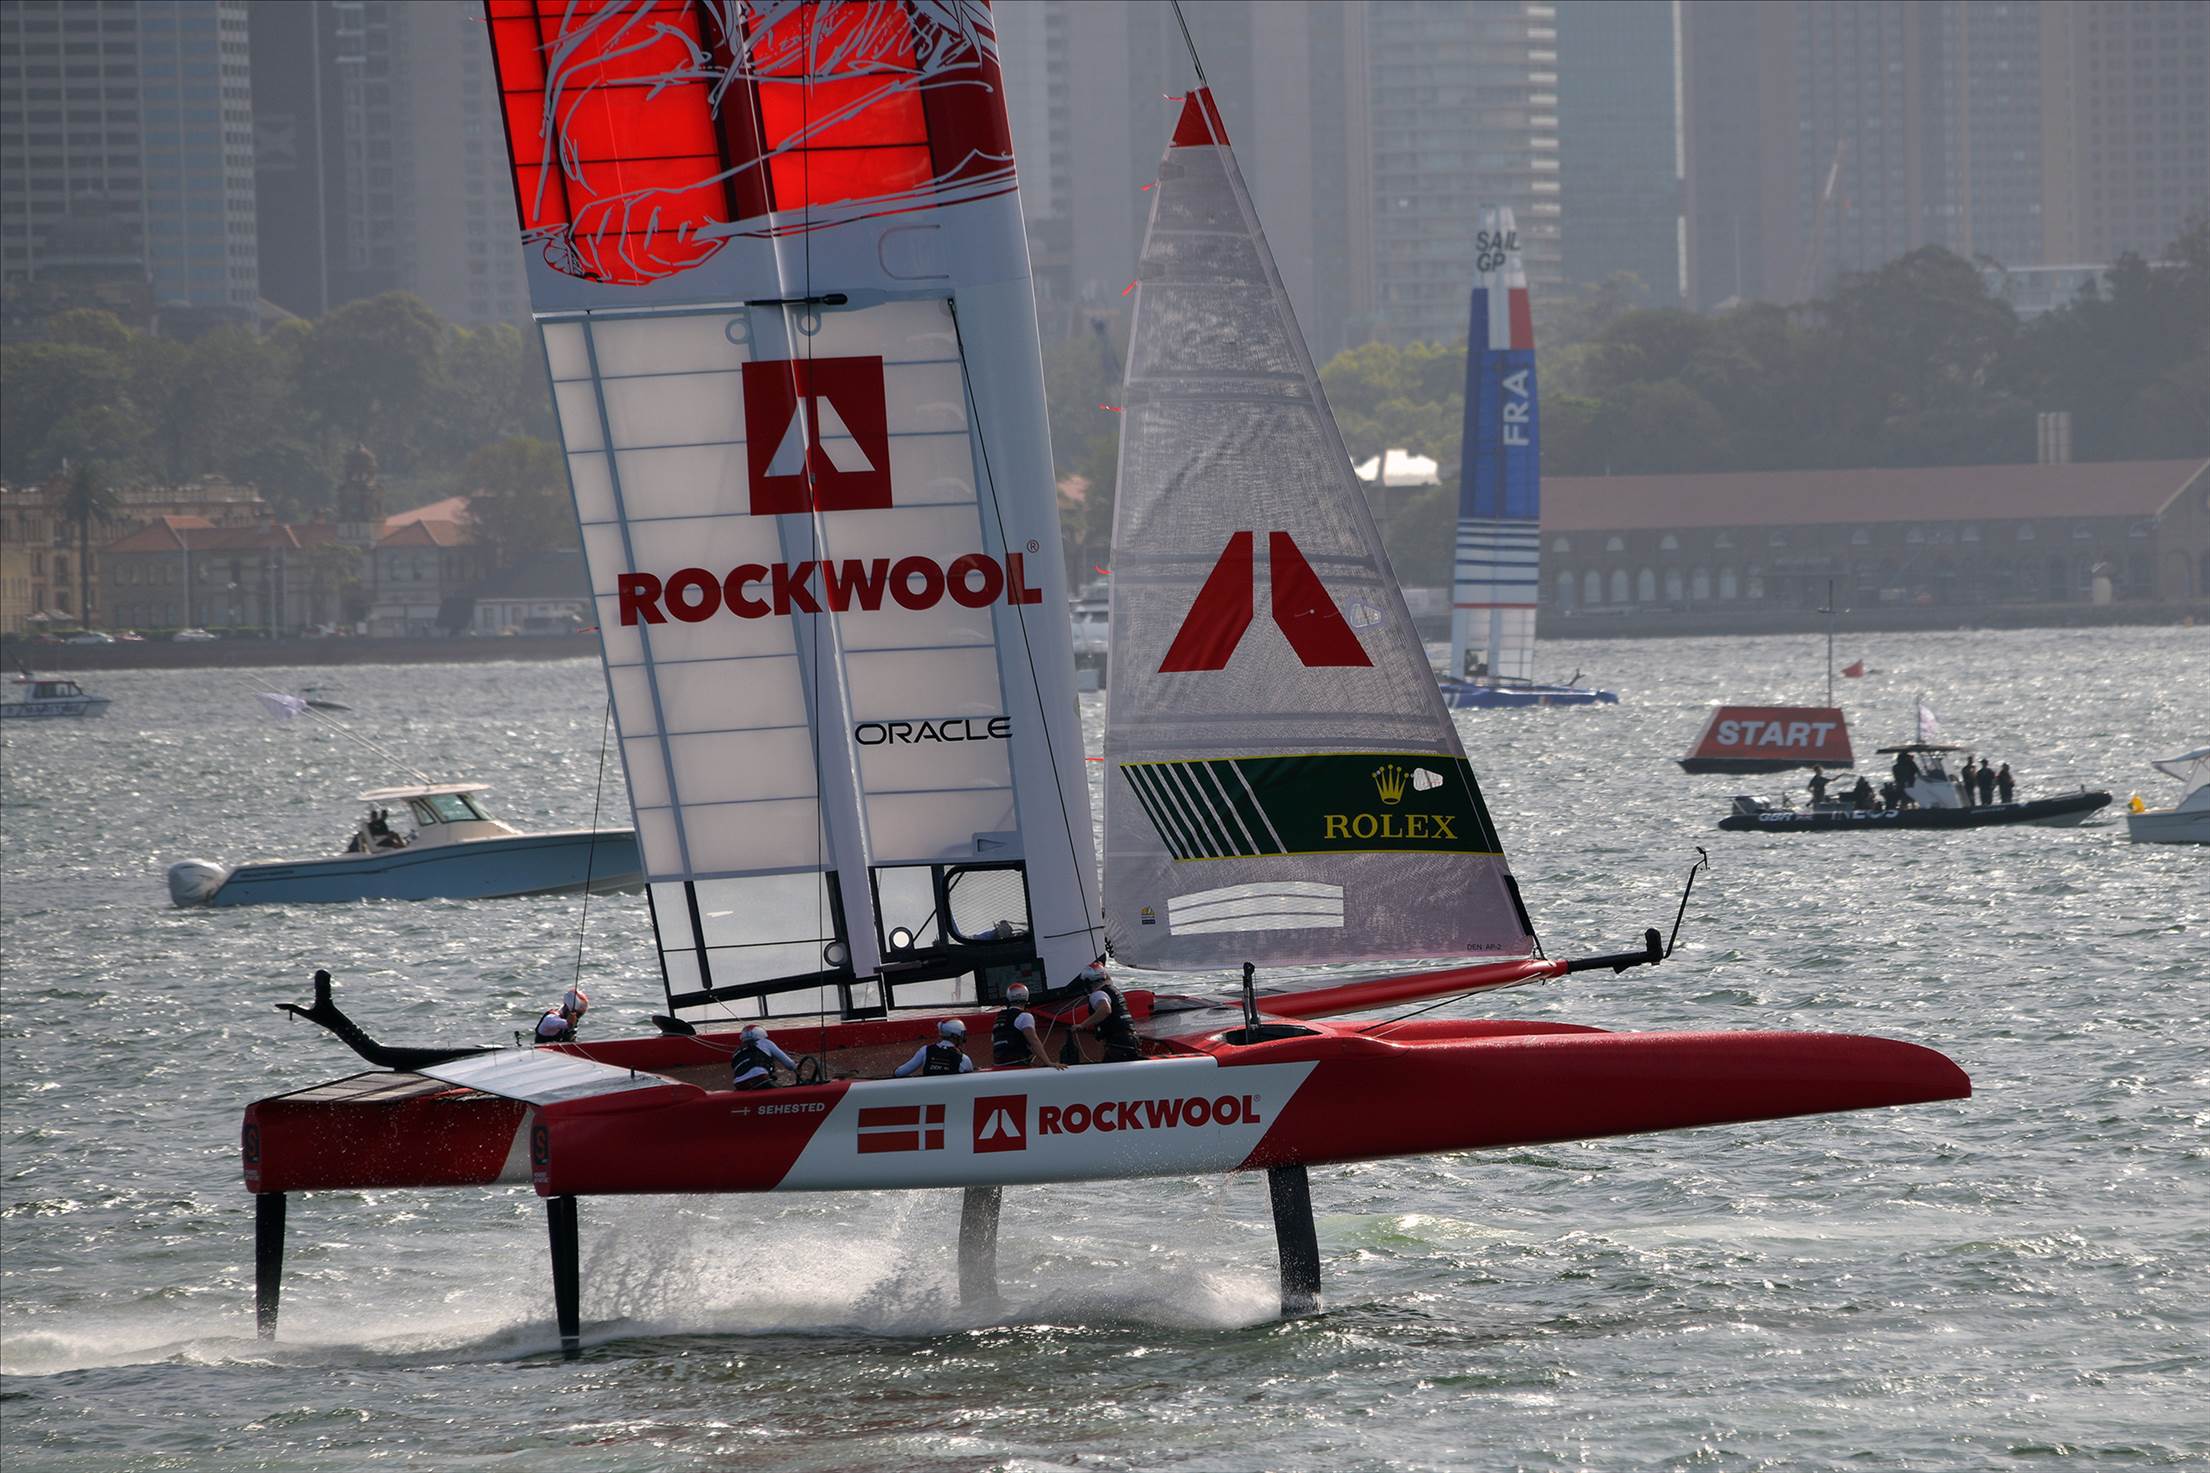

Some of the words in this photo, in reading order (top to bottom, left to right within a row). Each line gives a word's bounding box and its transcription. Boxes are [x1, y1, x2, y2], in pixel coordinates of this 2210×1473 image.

[1476, 231, 1521, 251] SAIL
[1476, 252, 1506, 273] GP
[1503, 368, 1530, 446] FRA
[855, 716, 1013, 745] ORACLE
[1716, 719, 1837, 748] START
[1324, 813, 1458, 840] ROLEX
[757, 1102, 825, 1115] SEHESTED
